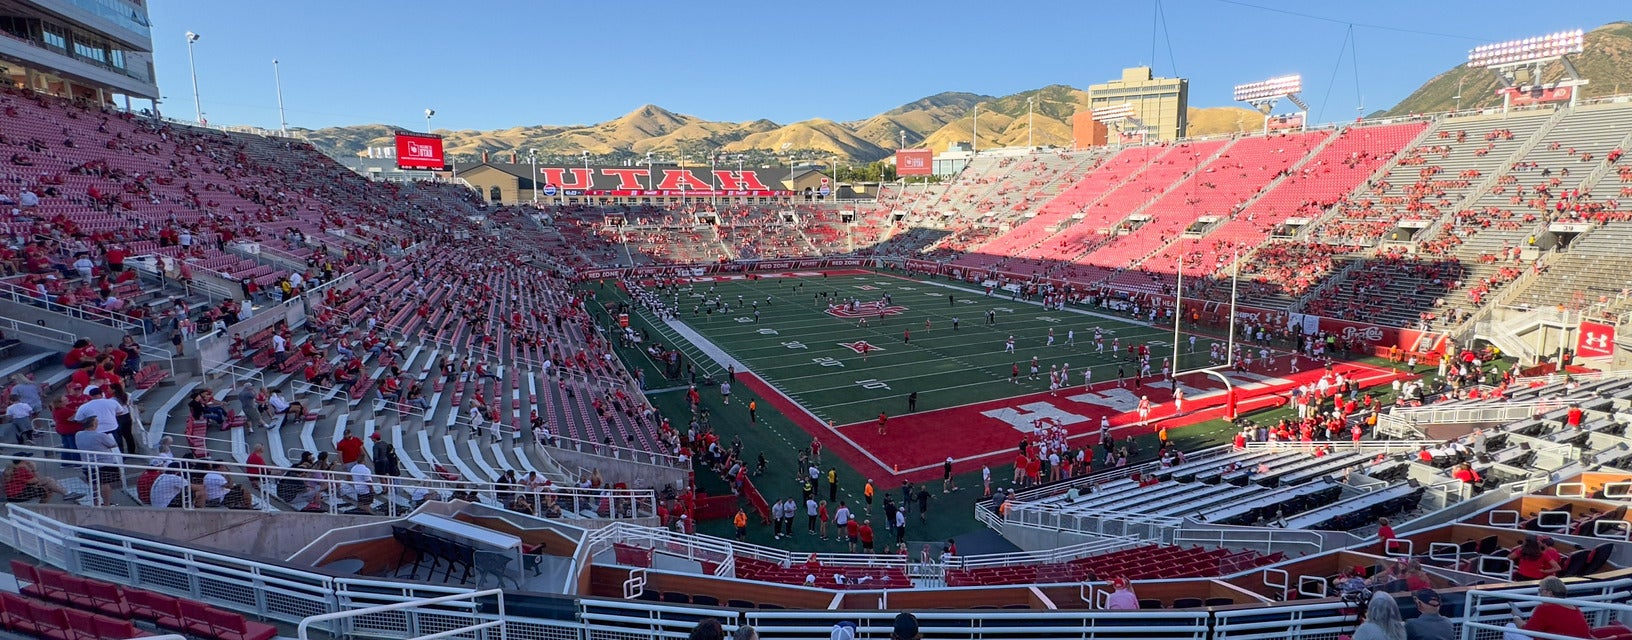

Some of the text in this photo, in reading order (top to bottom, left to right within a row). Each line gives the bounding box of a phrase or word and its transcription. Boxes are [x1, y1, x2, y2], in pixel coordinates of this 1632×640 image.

[540, 168, 770, 190] UTAH
[602, 270, 619, 278] ZONE
[812, 356, 842, 367] 20
[855, 379, 888, 390] 10
